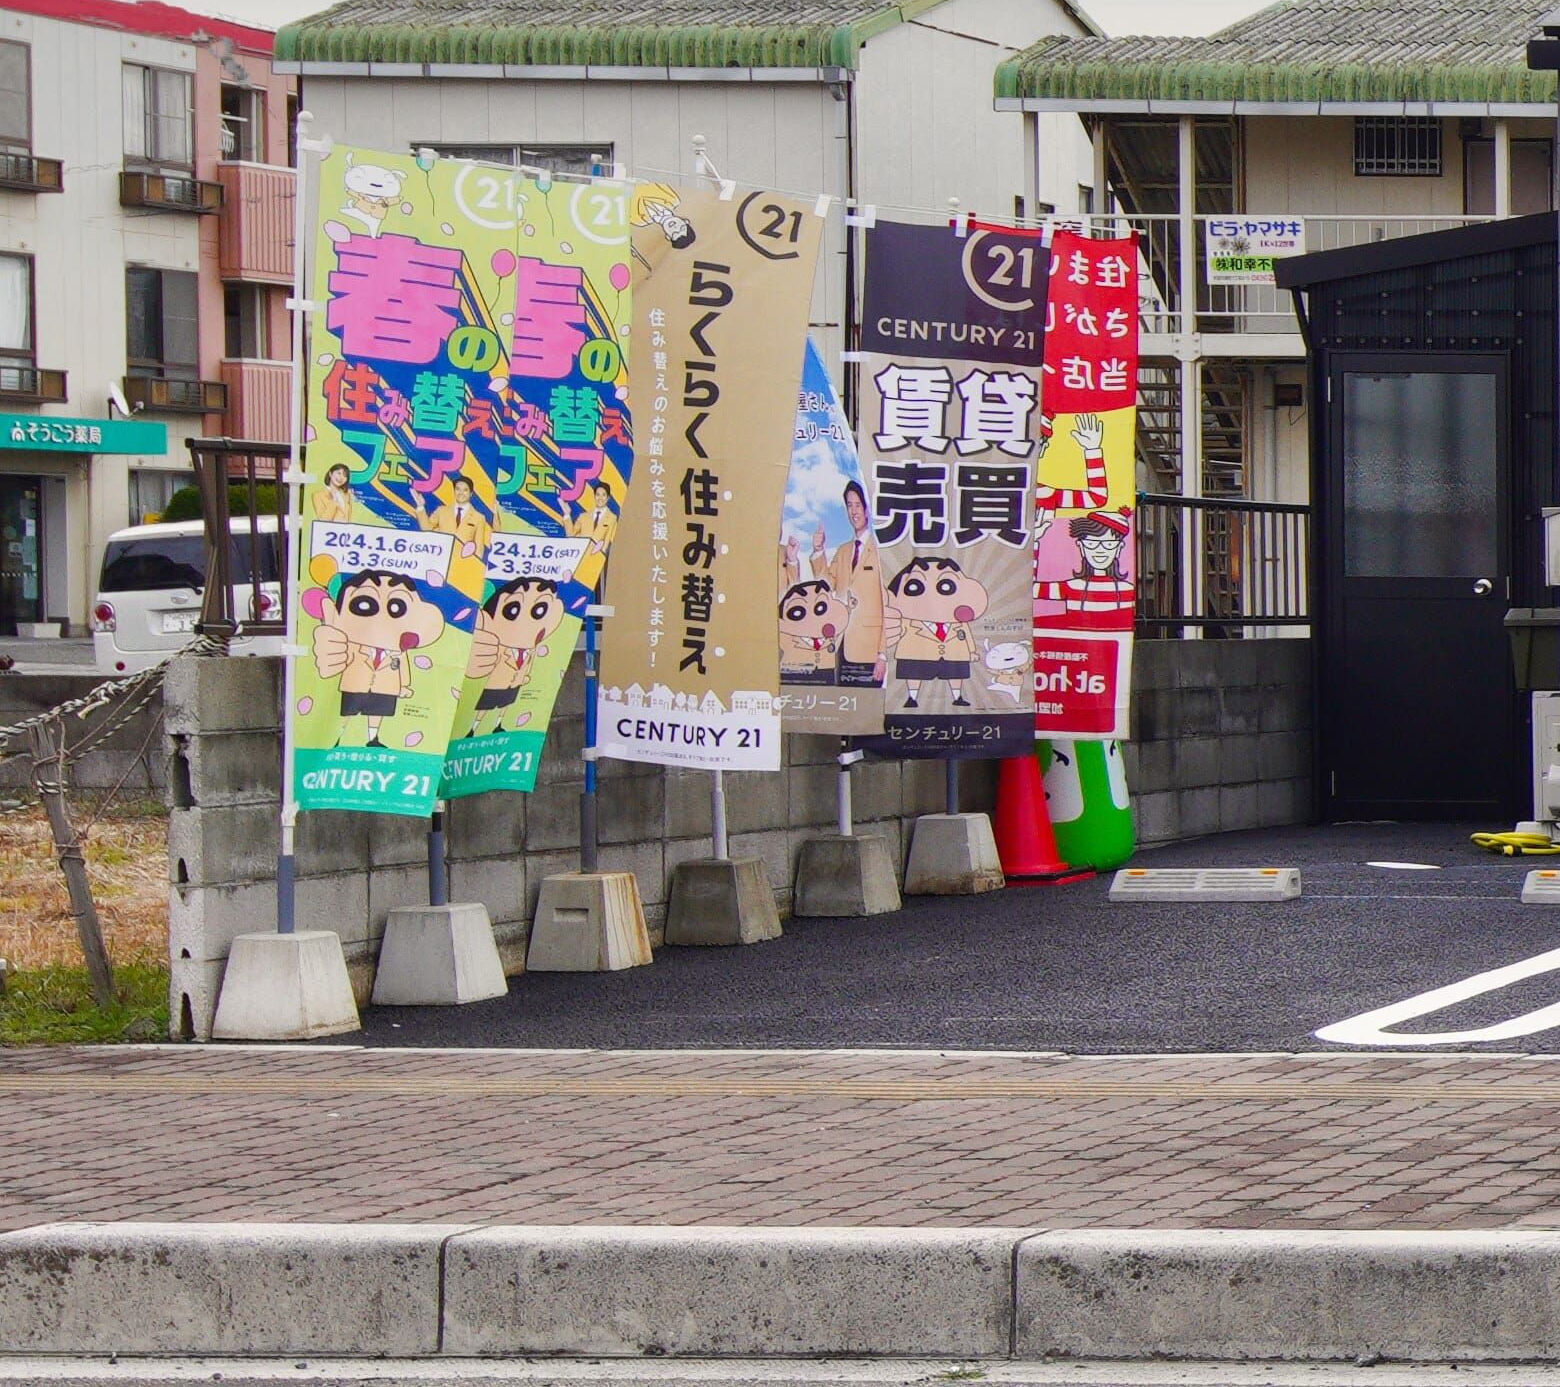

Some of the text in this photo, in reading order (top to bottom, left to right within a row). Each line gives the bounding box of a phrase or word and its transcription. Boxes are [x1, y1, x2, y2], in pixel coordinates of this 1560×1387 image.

[1209, 221, 1301, 236] ビラ・ヤマサキ
[326, 231, 501, 374] 春の
[877, 317, 1035, 350] CENTURY 21
[322, 358, 498, 440] 住み替え
[500, 385, 630, 447] み替え
[873, 363, 1039, 458] 賃貸
[340, 429, 467, 493] フェア
[679, 260, 734, 675] らくらく住み替え
[872, 461, 1032, 549] 売買
[508, 751, 533, 772] 21
[617, 718, 761, 748] CENTURY 21
[888, 725, 1001, 740] センチュリー21
[402, 773, 431, 797] 21
